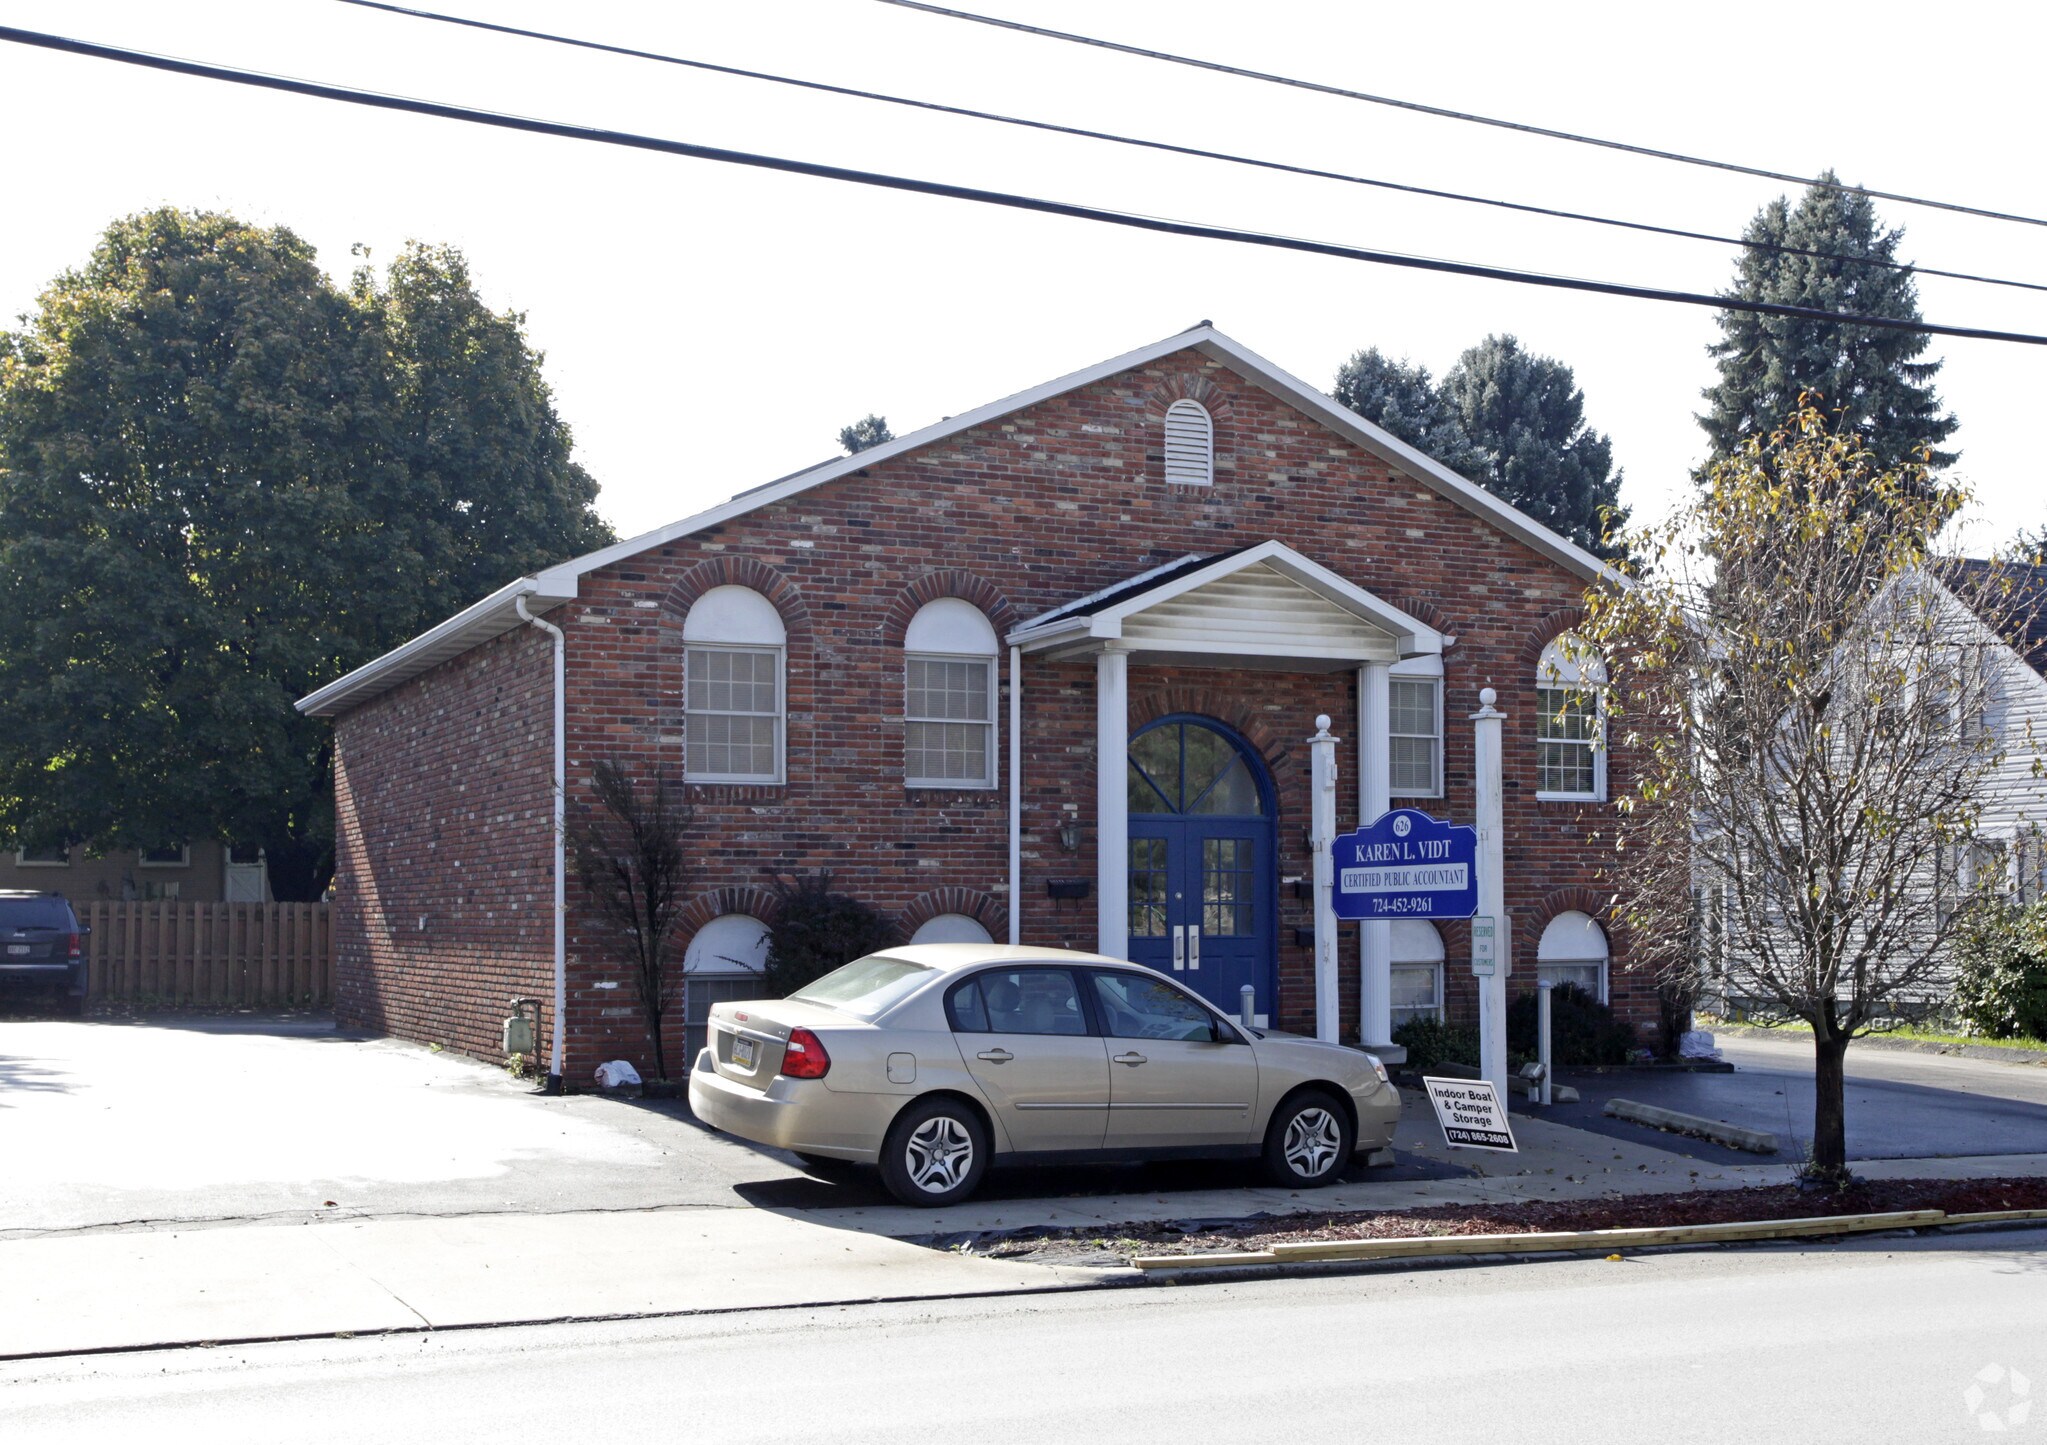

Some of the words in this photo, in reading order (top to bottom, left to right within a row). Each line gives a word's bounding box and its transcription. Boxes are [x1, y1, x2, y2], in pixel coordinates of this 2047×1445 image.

[1396, 821, 1409, 831] 626
[1356, 844, 1400, 861] KAREN
[1404, 843, 1415, 860] L.
[1419, 840, 1451, 858] VIDT
[1344, 873, 1381, 887] CERTIFIED
[1384, 871, 1410, 886] PUBLIC
[1413, 870, 1464, 885] ACCOUNTANT
[1373, 898, 1432, 912] 724-452-9261
[1479, 944, 1488, 953] FOR
[1435, 1088, 1465, 1098] Indoor
[1468, 1091, 1492, 1101] Boat
[1444, 1100, 1451, 1109] &
[1454, 1102, 1492, 1114] Camper
[1454, 1113, 1492, 1127] Storage
[1449, 1130, 1470, 1141] (724)
[1471, 1132, 1509, 1144] 865-2608
